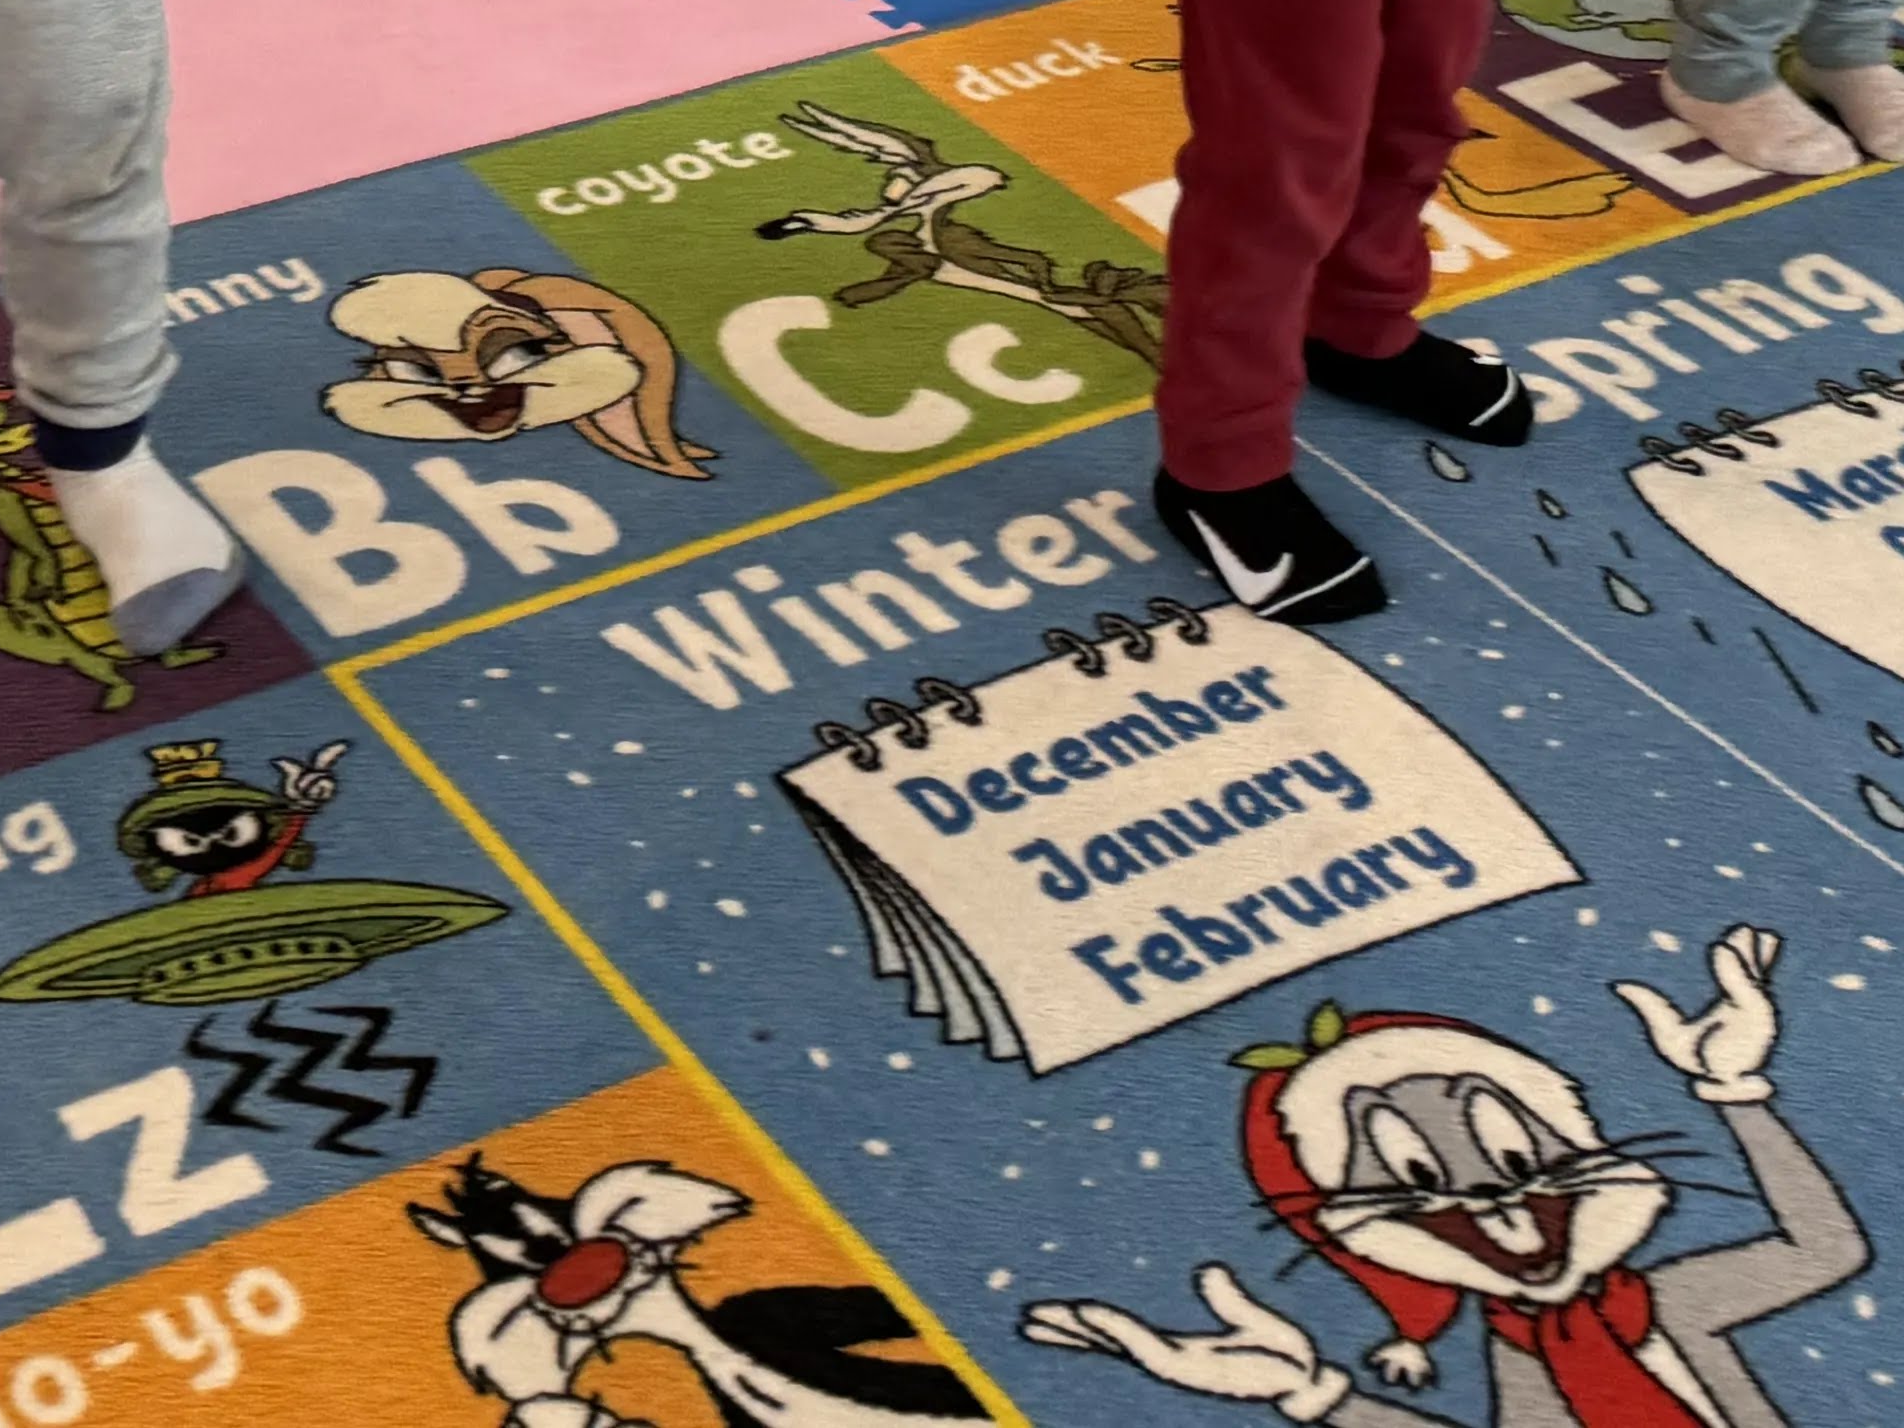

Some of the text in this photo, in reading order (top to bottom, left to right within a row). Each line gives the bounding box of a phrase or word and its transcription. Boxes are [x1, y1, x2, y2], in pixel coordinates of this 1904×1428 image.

[953, 38, 1123, 103] duck
[1497, 60, 1772, 200] E
[535, 123, 794, 217] coyote
[716, 294, 1086, 454] Cc
[192, 449, 620, 639] Bb
[600, 488, 1160, 711] Winter
[894, 664, 1290, 838] December
[1013, 750, 1374, 905] January
[1069, 824, 1478, 1005] February
